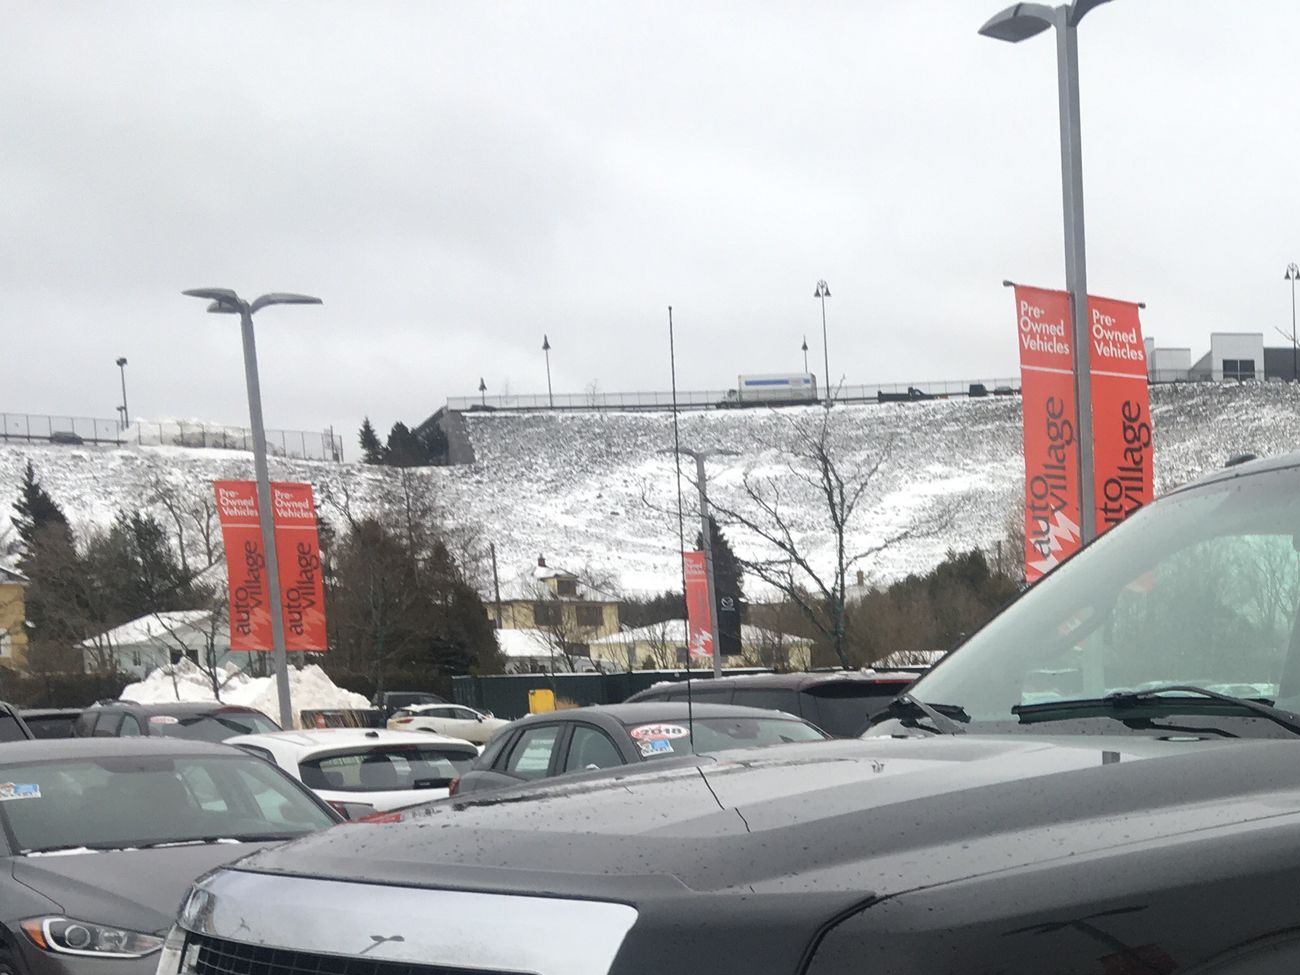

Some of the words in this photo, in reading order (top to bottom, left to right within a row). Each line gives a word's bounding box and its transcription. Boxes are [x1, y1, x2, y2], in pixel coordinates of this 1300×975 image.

[1020, 300, 1045, 318] Pre-
[1092, 308, 1117, 326] Pre-
[1020, 316, 1064, 337] Owned
[1092, 324, 1137, 344] Owned
[1021, 334, 1070, 355] Vehicles
[1094, 341, 1144, 361] Vehicles
[1043, 396, 1075, 516] village
[219, 488, 239, 499] Pre-
[220, 496, 254, 508] Owned
[275, 489, 294, 501] Pre-
[222, 505, 258, 518] Vehicles
[275, 498, 310, 510] Owned
[276, 507, 314, 520] Vehicles
[1030, 475, 1051, 558] auto
[244, 541, 266, 611] village
[297, 542, 319, 610] village
[235, 587, 250, 637] auto
[286, 588, 304, 637] auto
